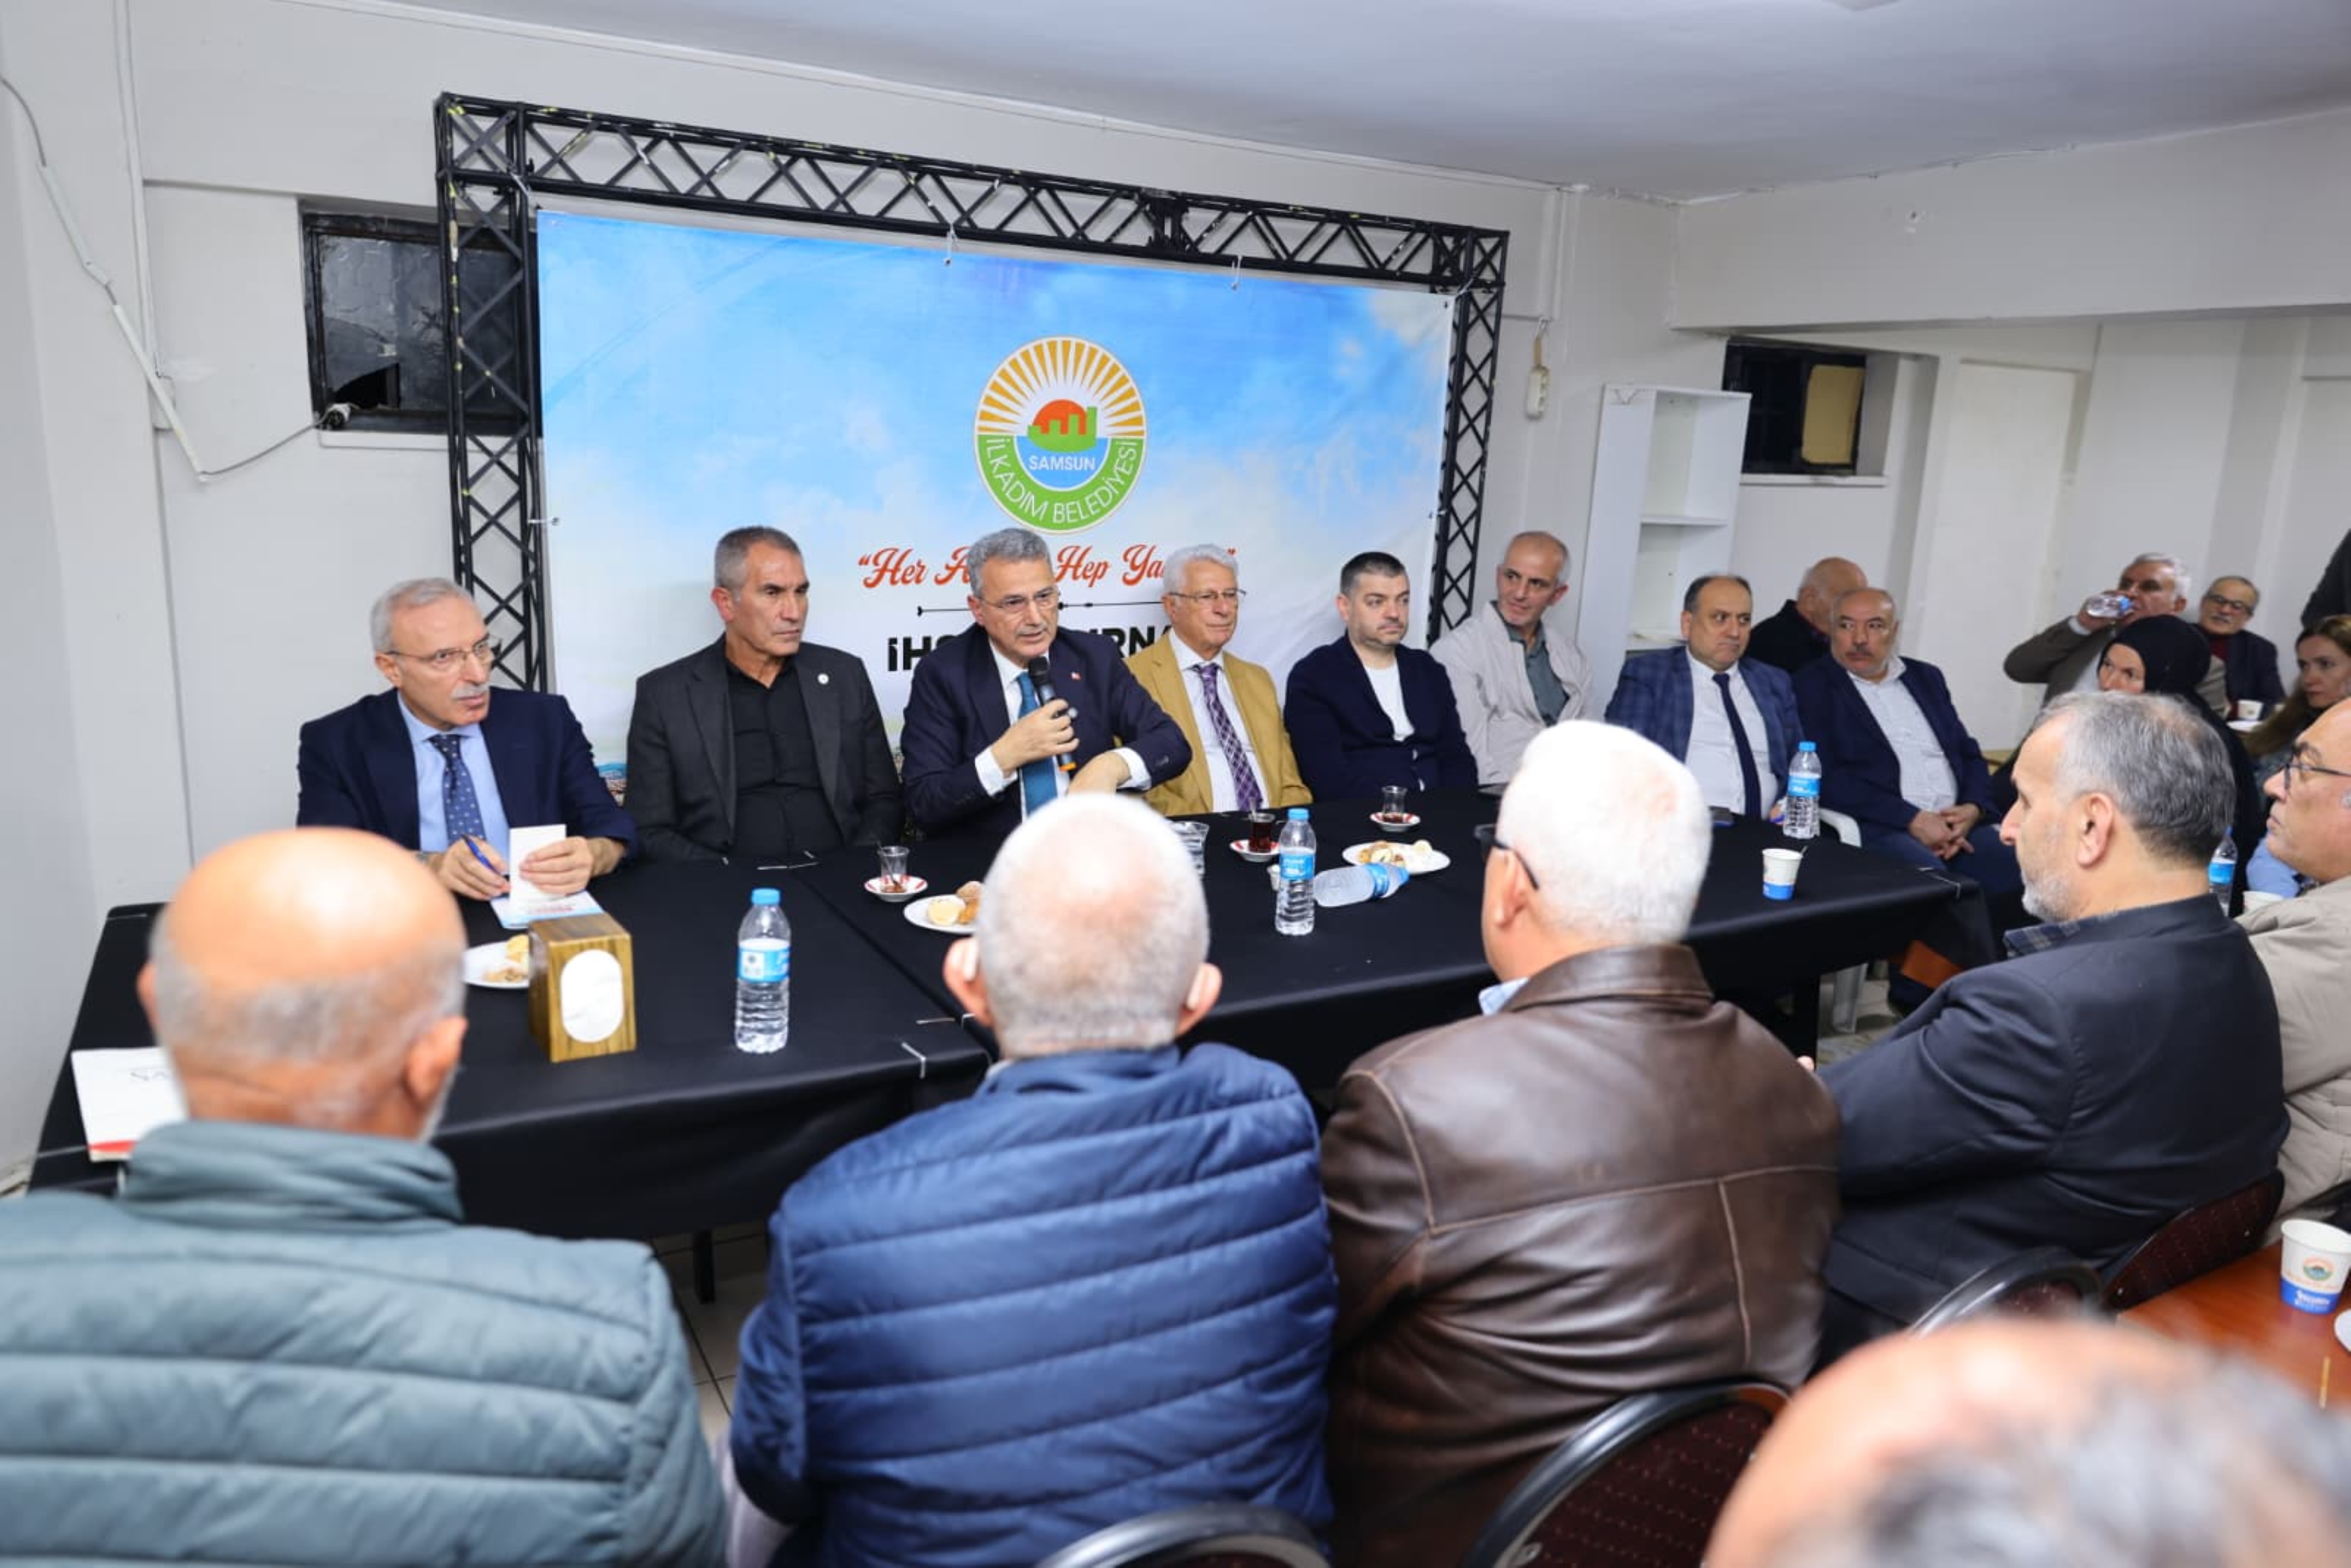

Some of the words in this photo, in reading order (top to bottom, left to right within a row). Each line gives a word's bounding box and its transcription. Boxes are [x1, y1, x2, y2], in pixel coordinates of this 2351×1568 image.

[987, 438, 1049, 521] İLKADIM
[1052, 441, 1138, 523] BELEDİYESİ
[1029, 456, 1095, 470] SAMSUN
[1055, 545, 1111, 588] Hep
